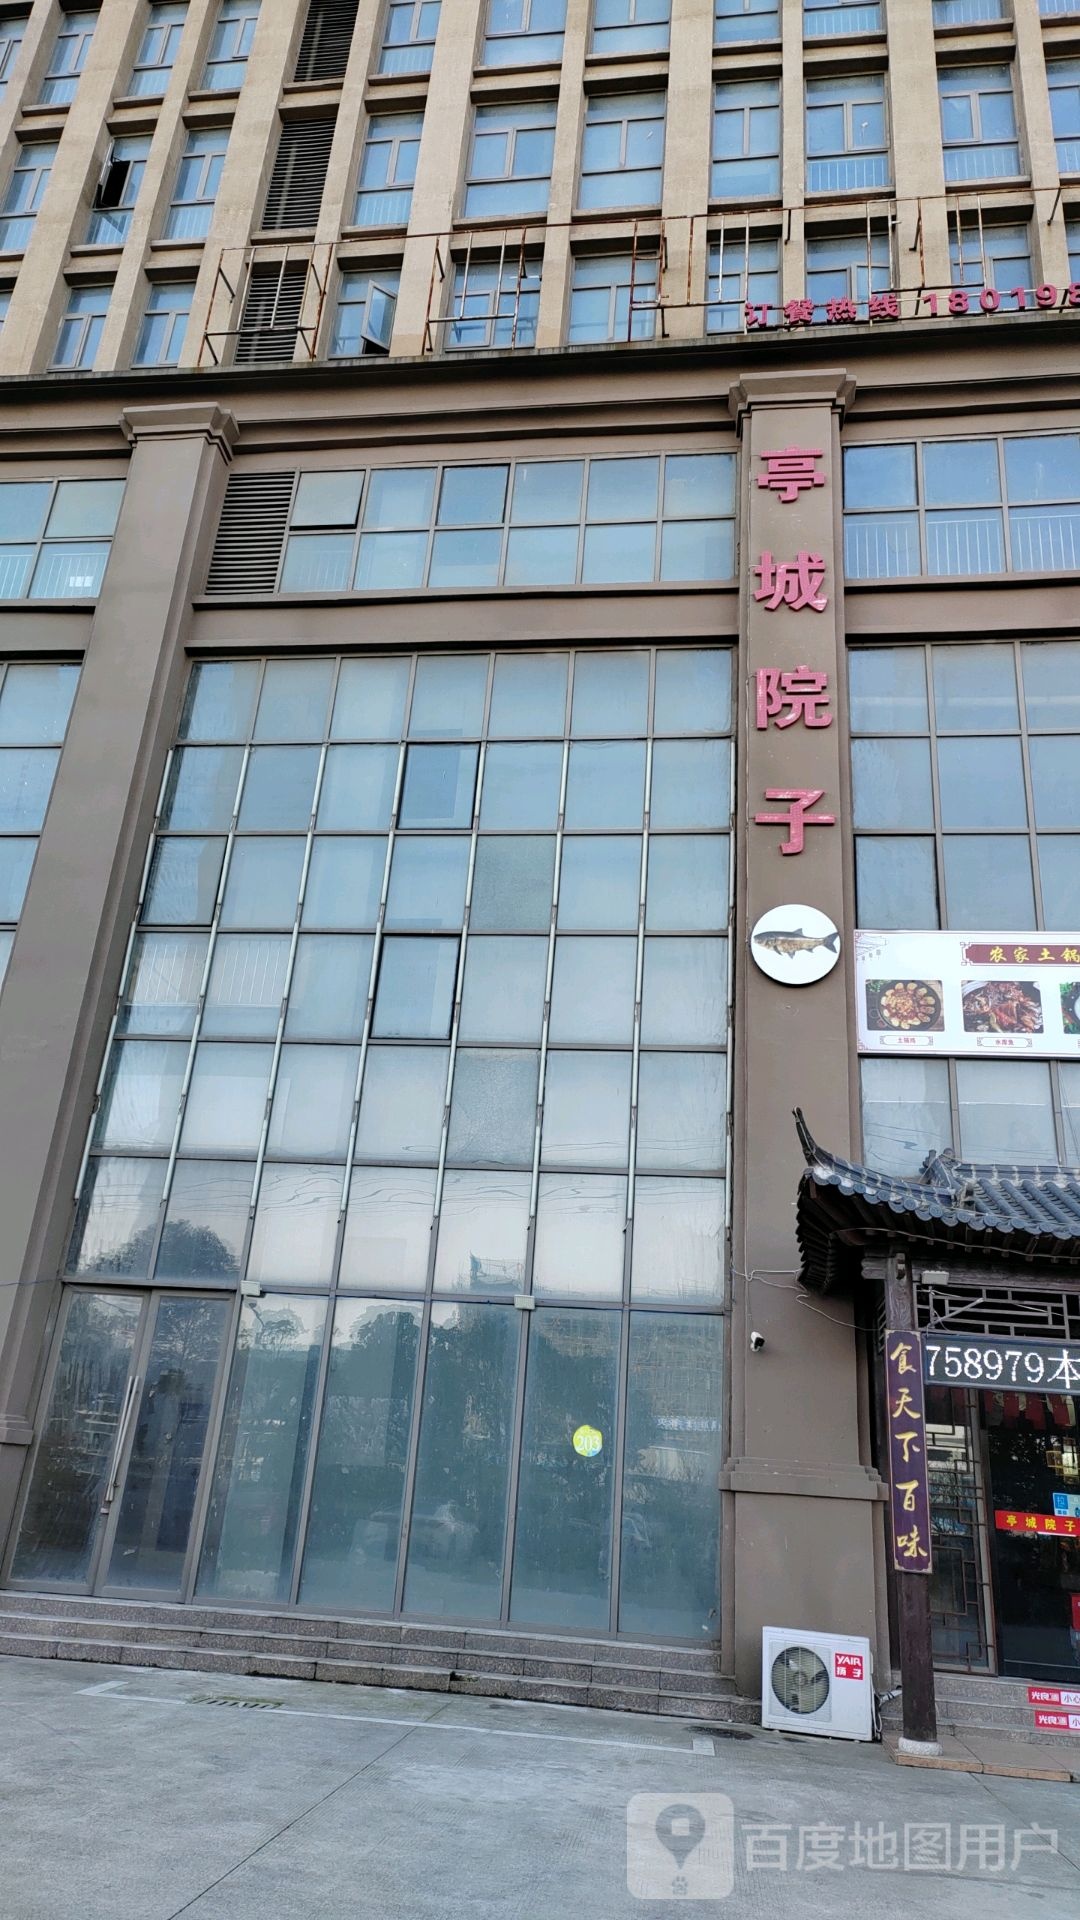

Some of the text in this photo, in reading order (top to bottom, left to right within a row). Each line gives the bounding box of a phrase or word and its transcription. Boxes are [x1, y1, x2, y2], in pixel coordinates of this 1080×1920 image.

[745, 283, 1080, 327] 订餐热线 180198
[753, 445, 836, 856] 亭城院子
[925, 1346, 1080, 1389] 758979本
[890, 1341, 927, 1559] 食天下百味
[1006, 1514, 1076, 1532] 亭城院子
[837, 1655, 861, 1666] YAIR
